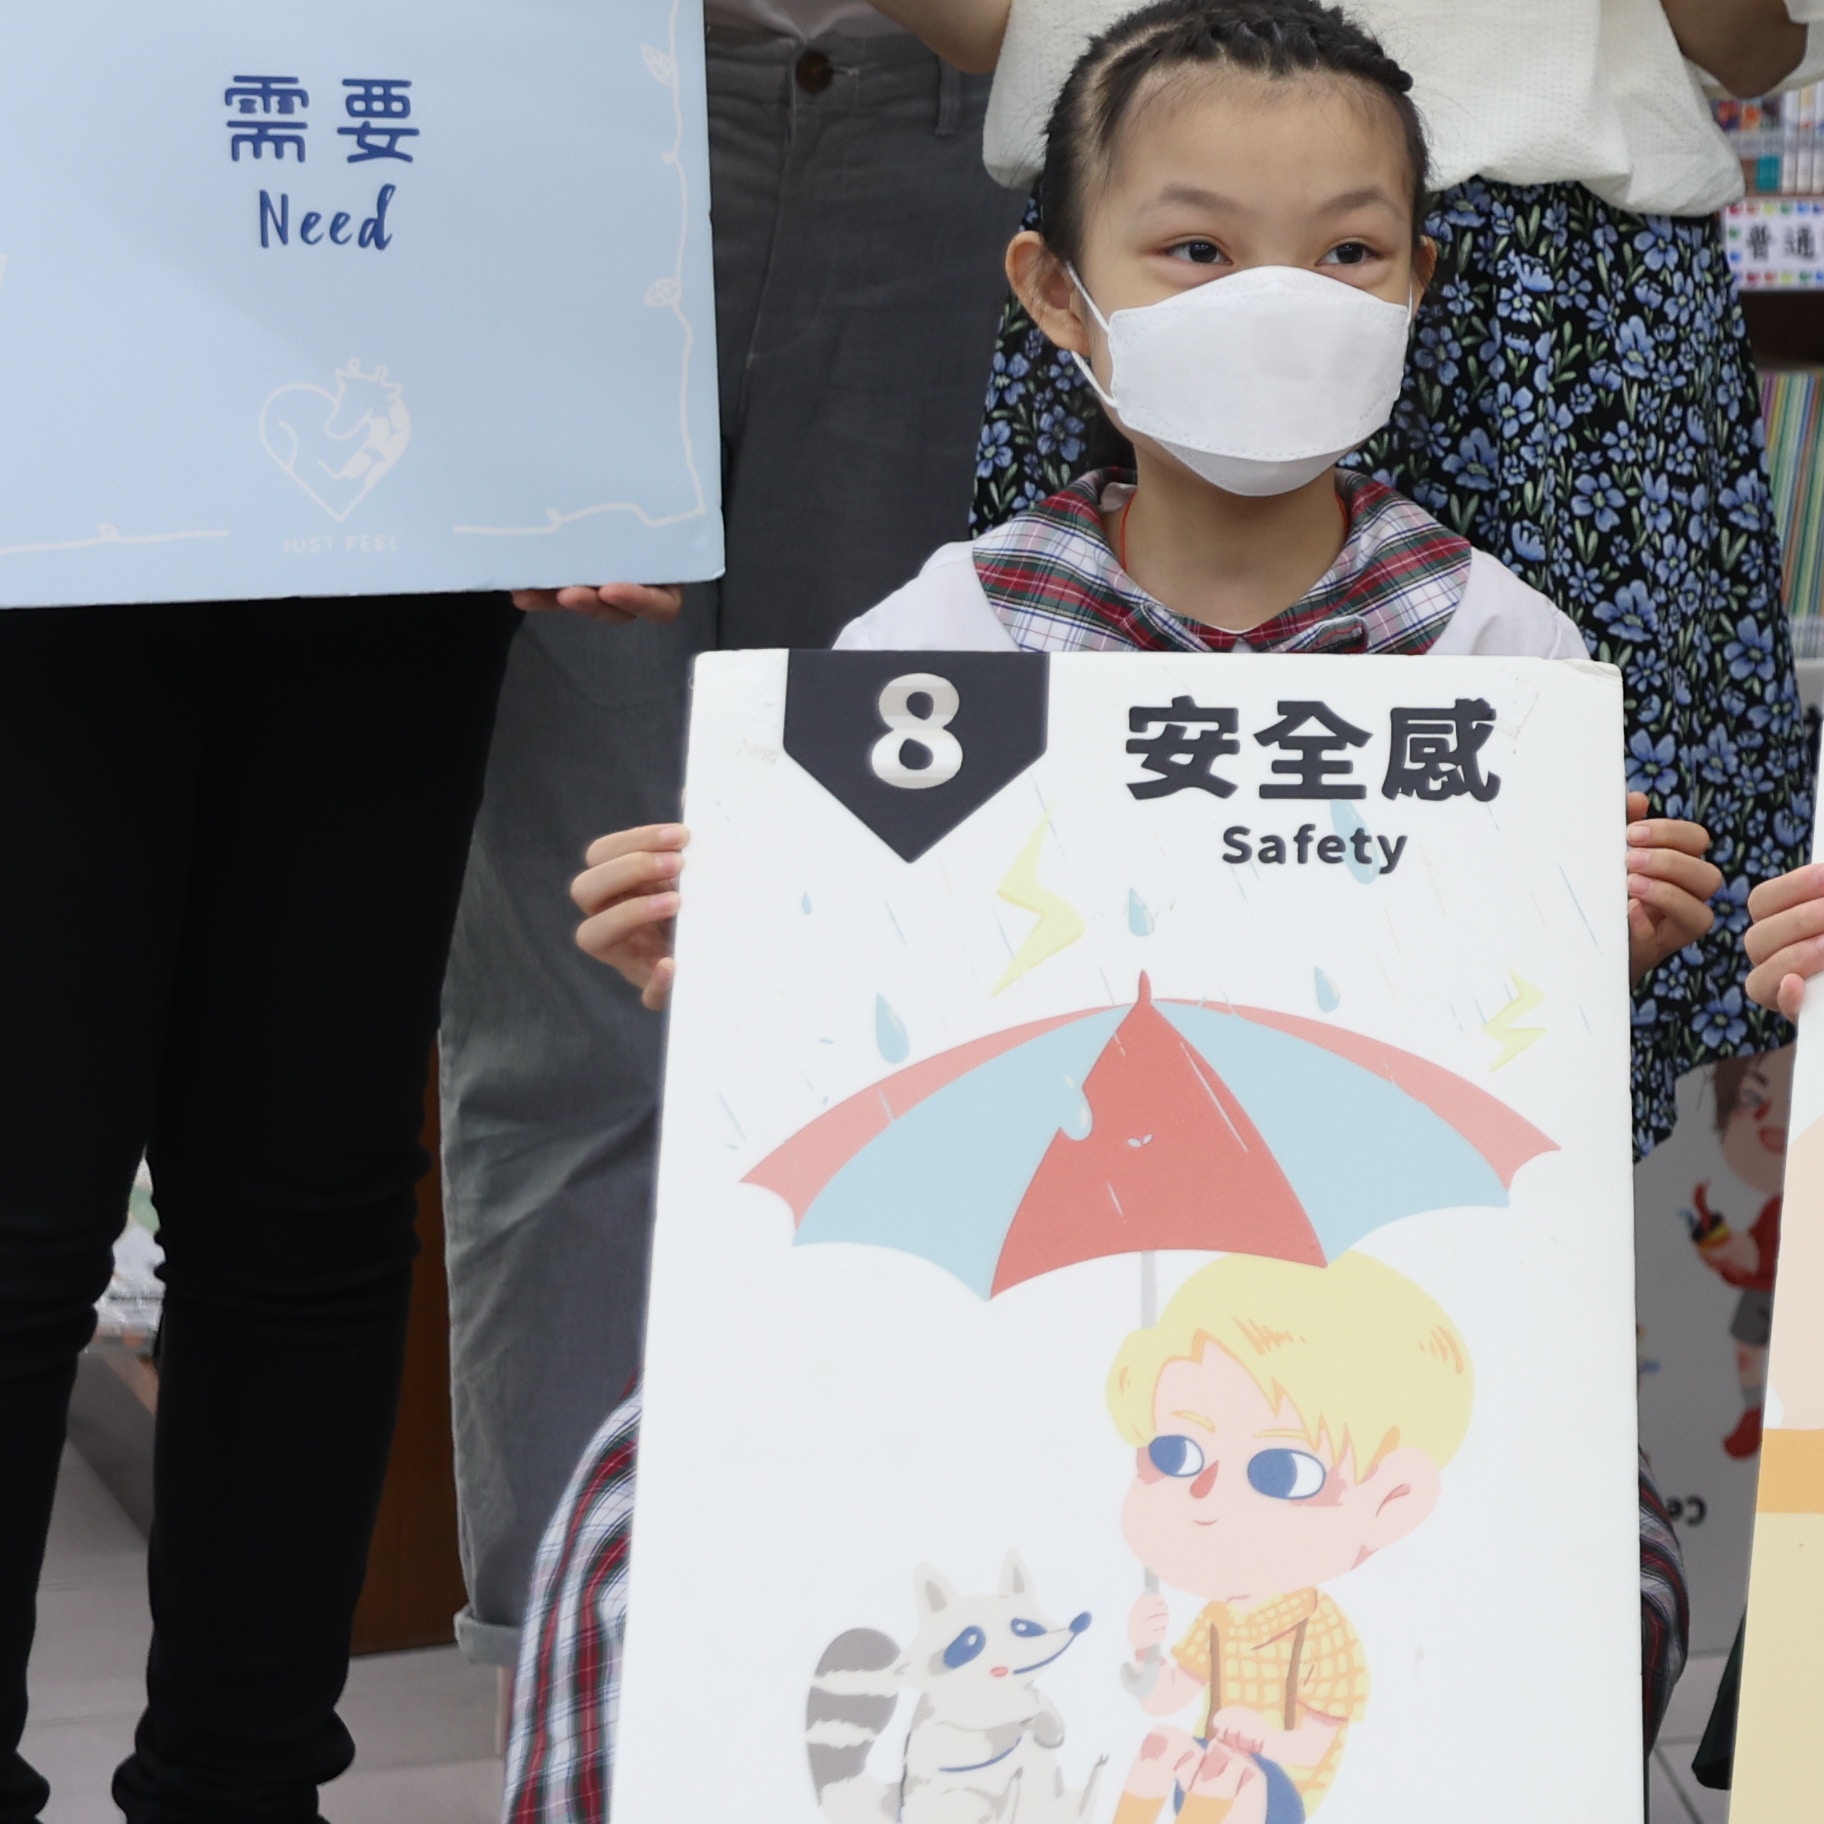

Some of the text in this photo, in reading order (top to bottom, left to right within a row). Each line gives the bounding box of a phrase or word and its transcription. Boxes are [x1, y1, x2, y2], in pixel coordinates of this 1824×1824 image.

[223, 74, 421, 165] 需要
[258, 183, 397, 252] Need
[870, 672, 964, 789] 8
[1125, 695, 1501, 802] 安全感
[1222, 823, 1408, 875] Safety
